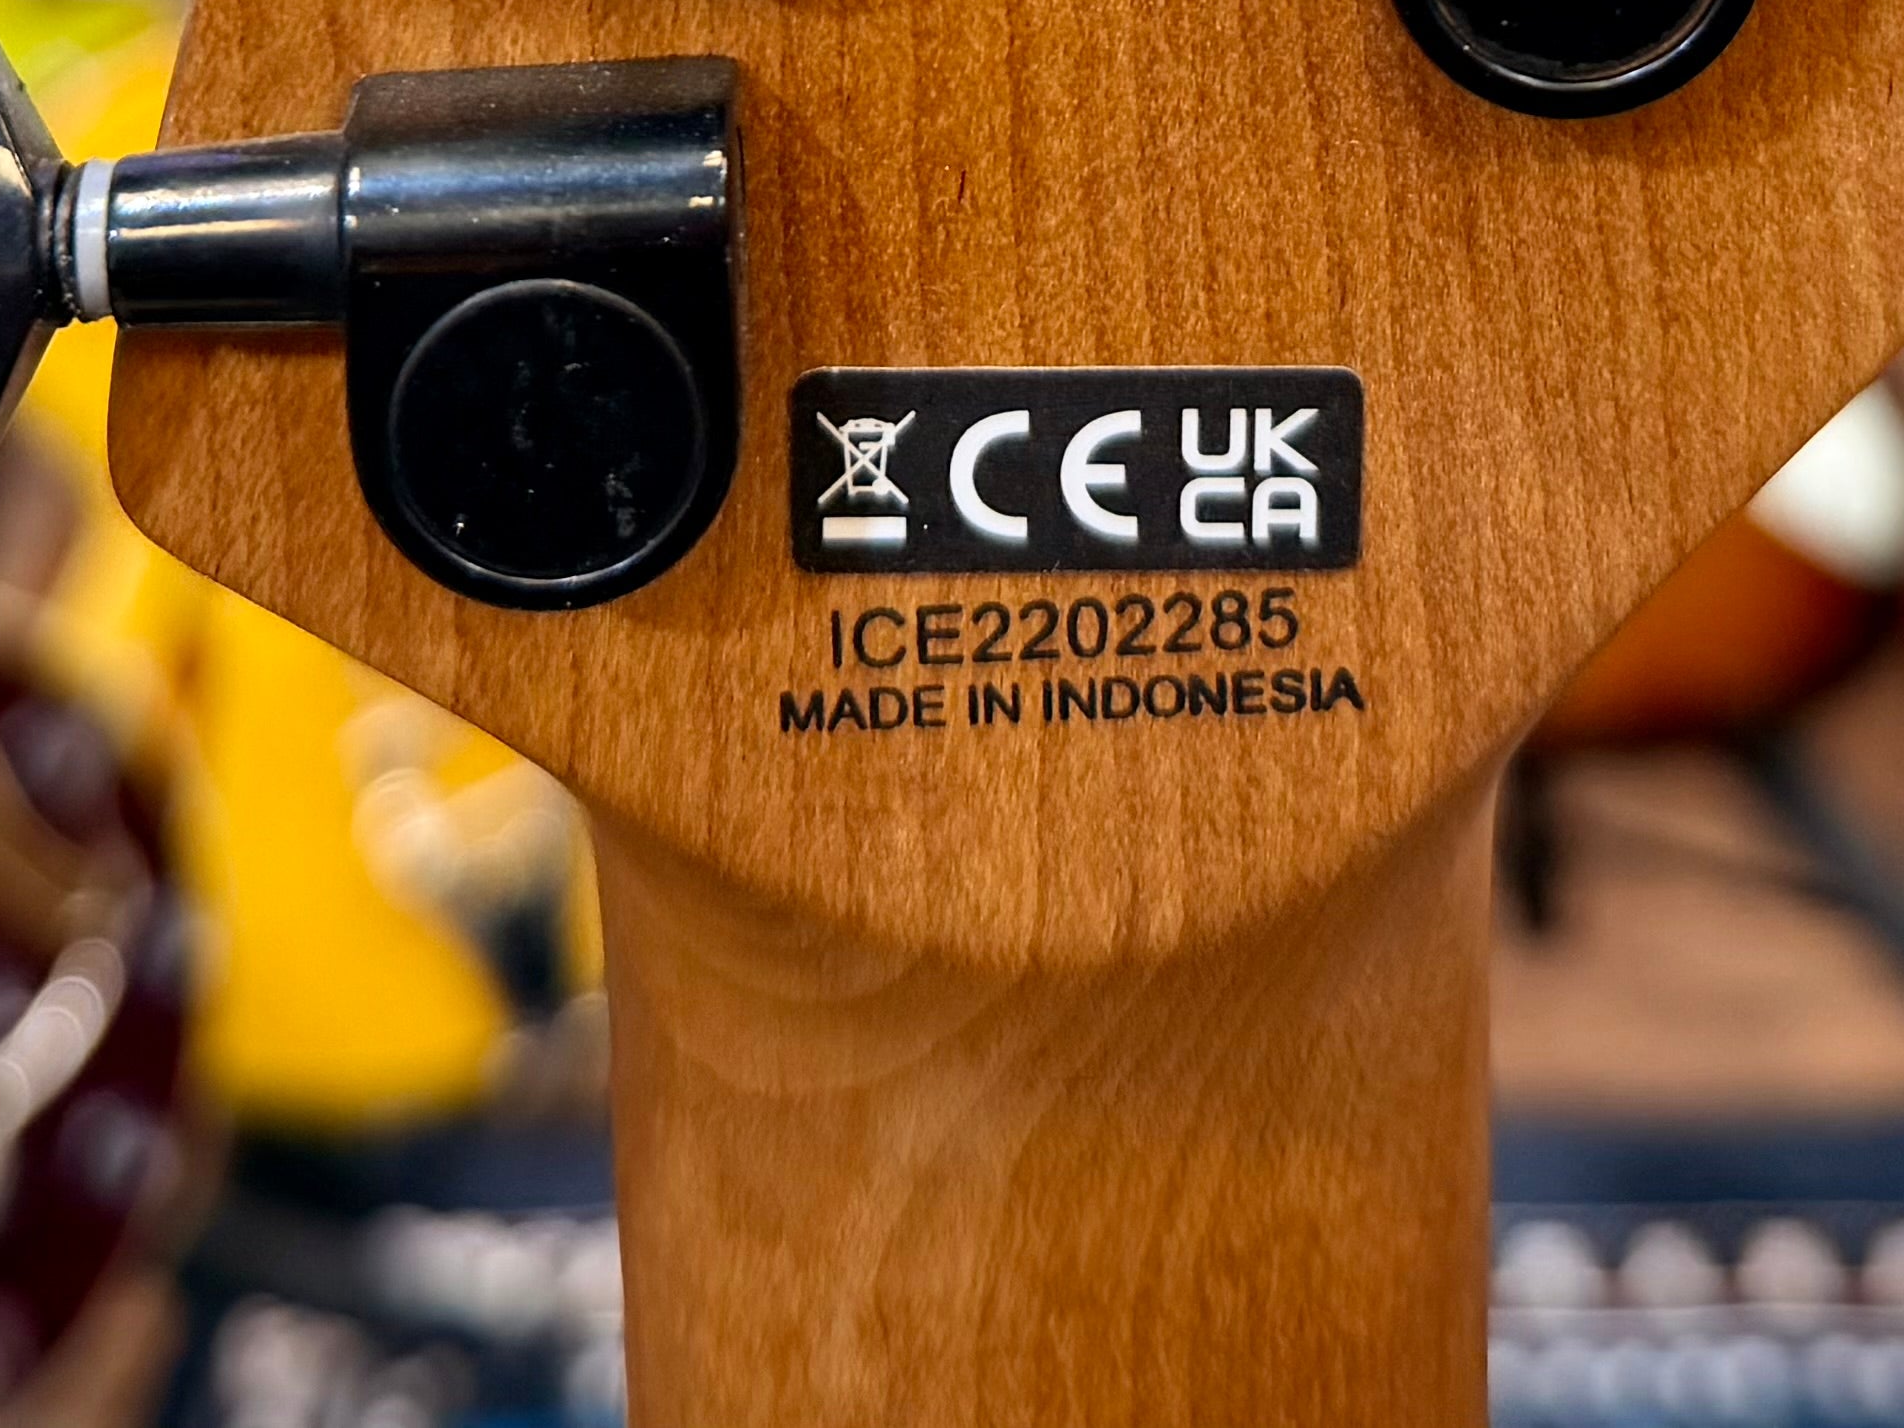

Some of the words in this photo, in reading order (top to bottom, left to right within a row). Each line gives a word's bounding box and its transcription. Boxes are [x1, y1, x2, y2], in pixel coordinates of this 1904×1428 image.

[949, 408, 1143, 539] CE
[1180, 407, 1320, 472] UK
[1179, 477, 1318, 540] CA
[830, 587, 1299, 669] ICE2202285
[778, 684, 947, 734] MADE
[967, 681, 1022, 726] IN
[1041, 666, 1366, 724] INDONESIA
